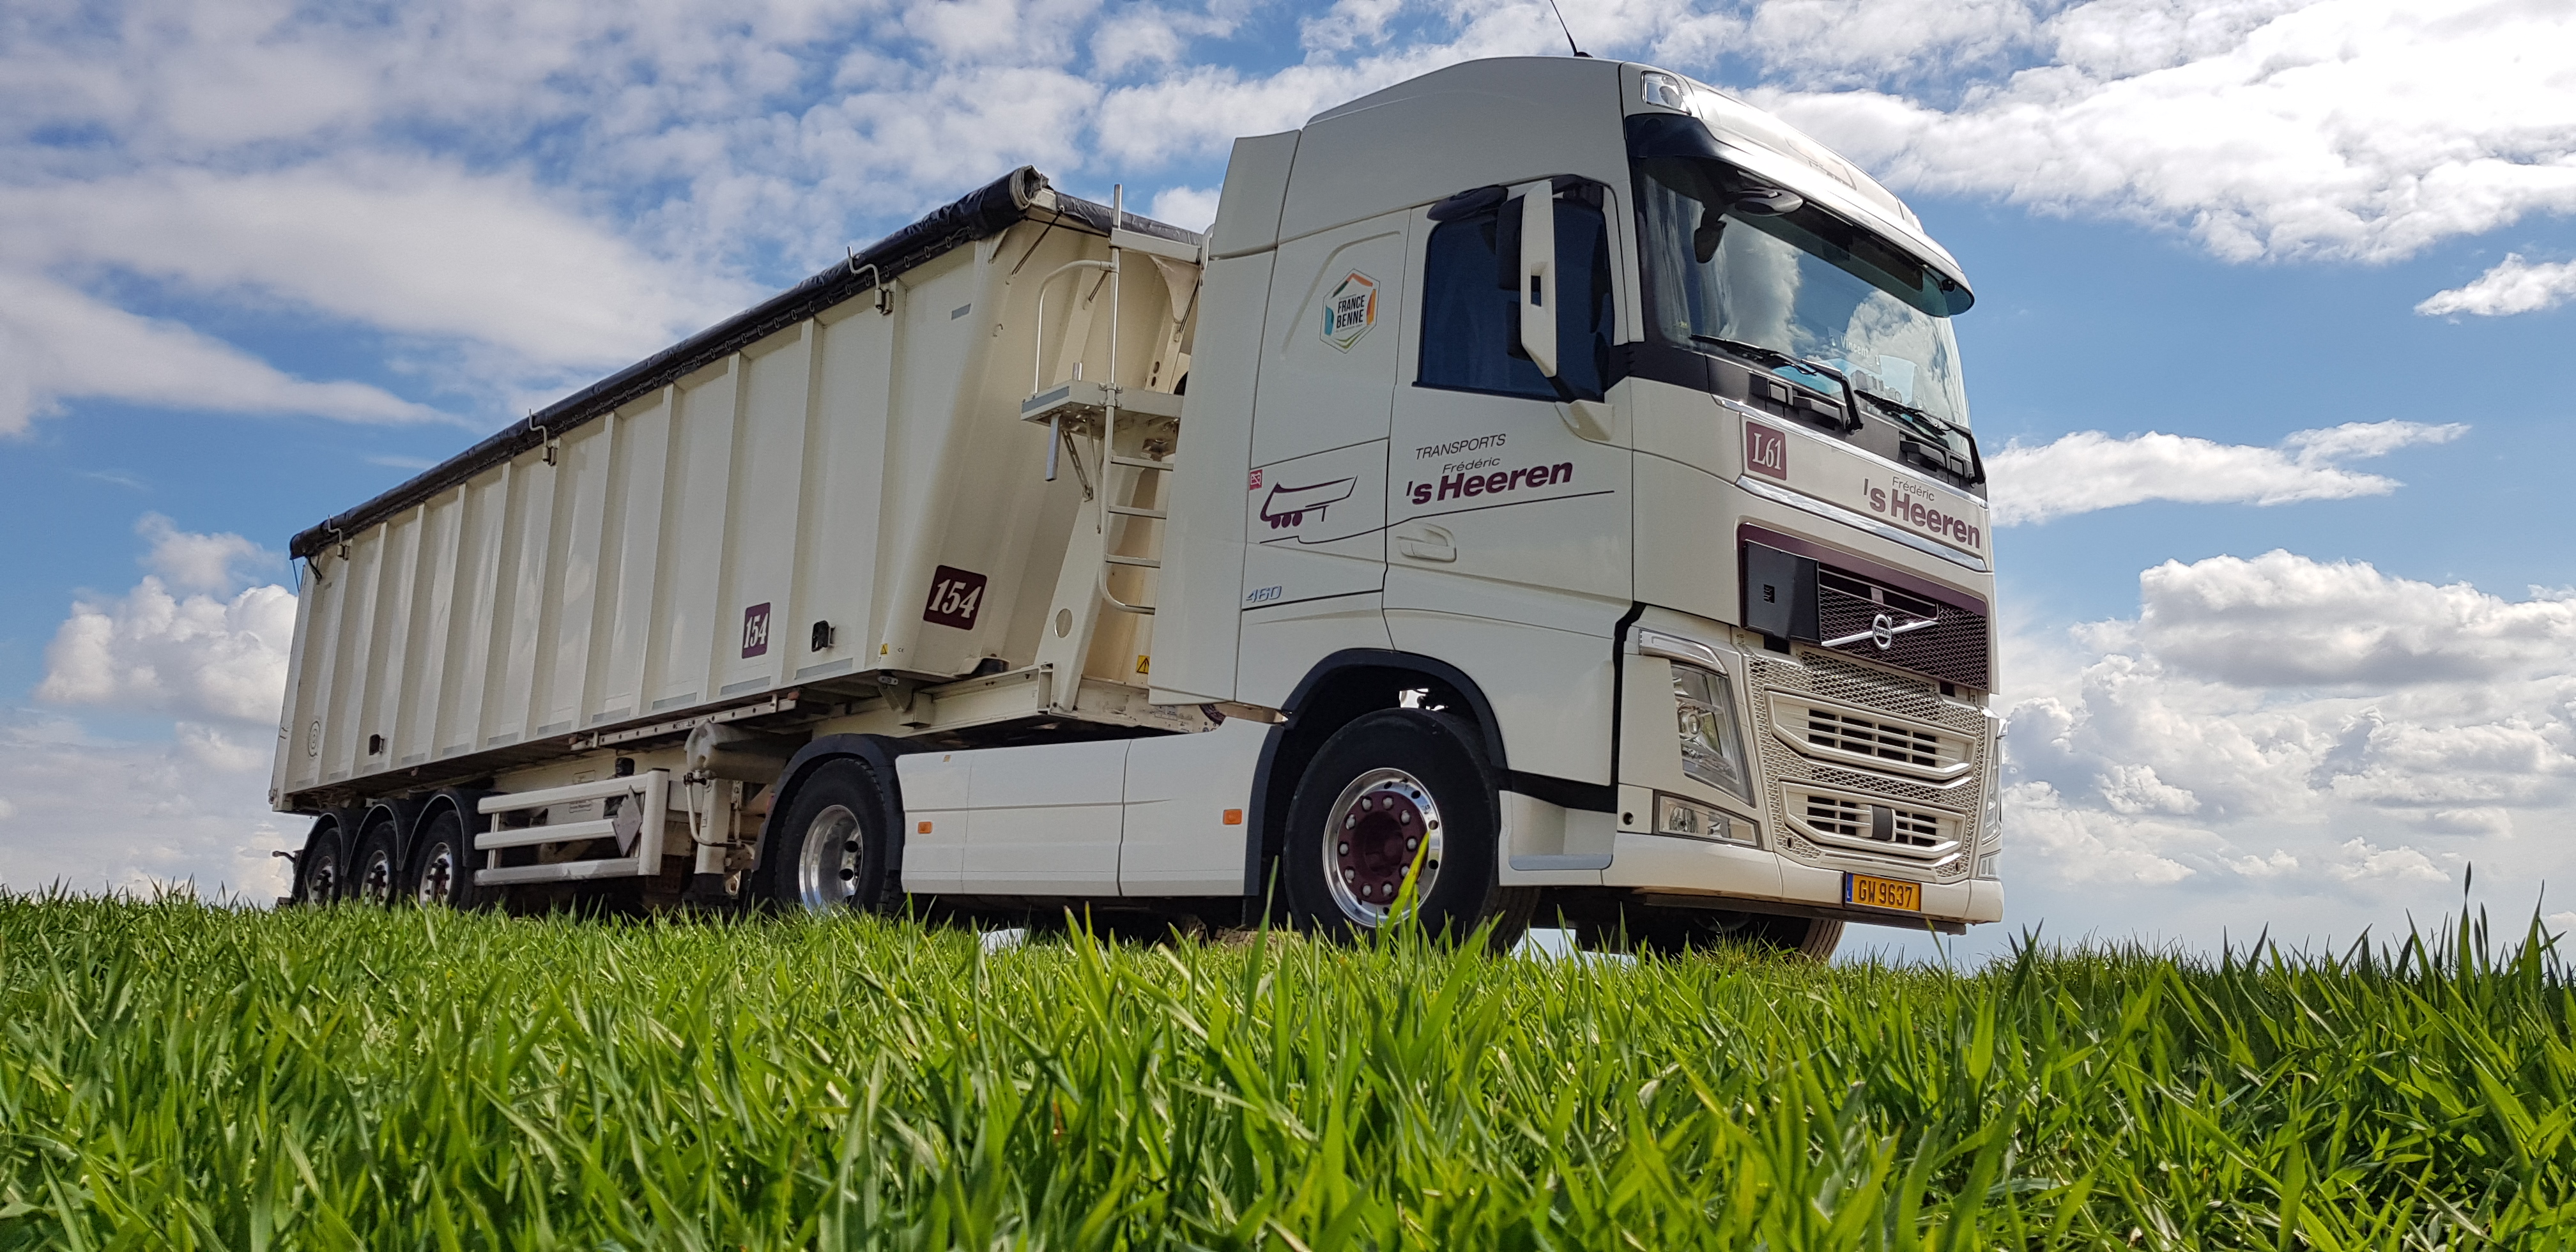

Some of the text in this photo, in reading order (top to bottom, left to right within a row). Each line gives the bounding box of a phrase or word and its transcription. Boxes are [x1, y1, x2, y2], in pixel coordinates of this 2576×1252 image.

[1337, 294, 1365, 314] FRANCE
[1336, 309, 1364, 328] BENNE
[1840, 335, 1869, 358] Vincent
[1415, 434, 1506, 460] TRANSPORTS
[1752, 432, 1781, 470] L61
[1442, 457, 1501, 474] Frédéric
[1437, 461, 1573, 501] Heeren
[1892, 476, 1935, 501] Frédéric
[1890, 488, 1980, 549] Heeren
[928, 579, 982, 618] 154
[1246, 586, 1282, 602] 460
[744, 613, 769, 648] 154
[1859, 880, 1913, 907] GW 9637
